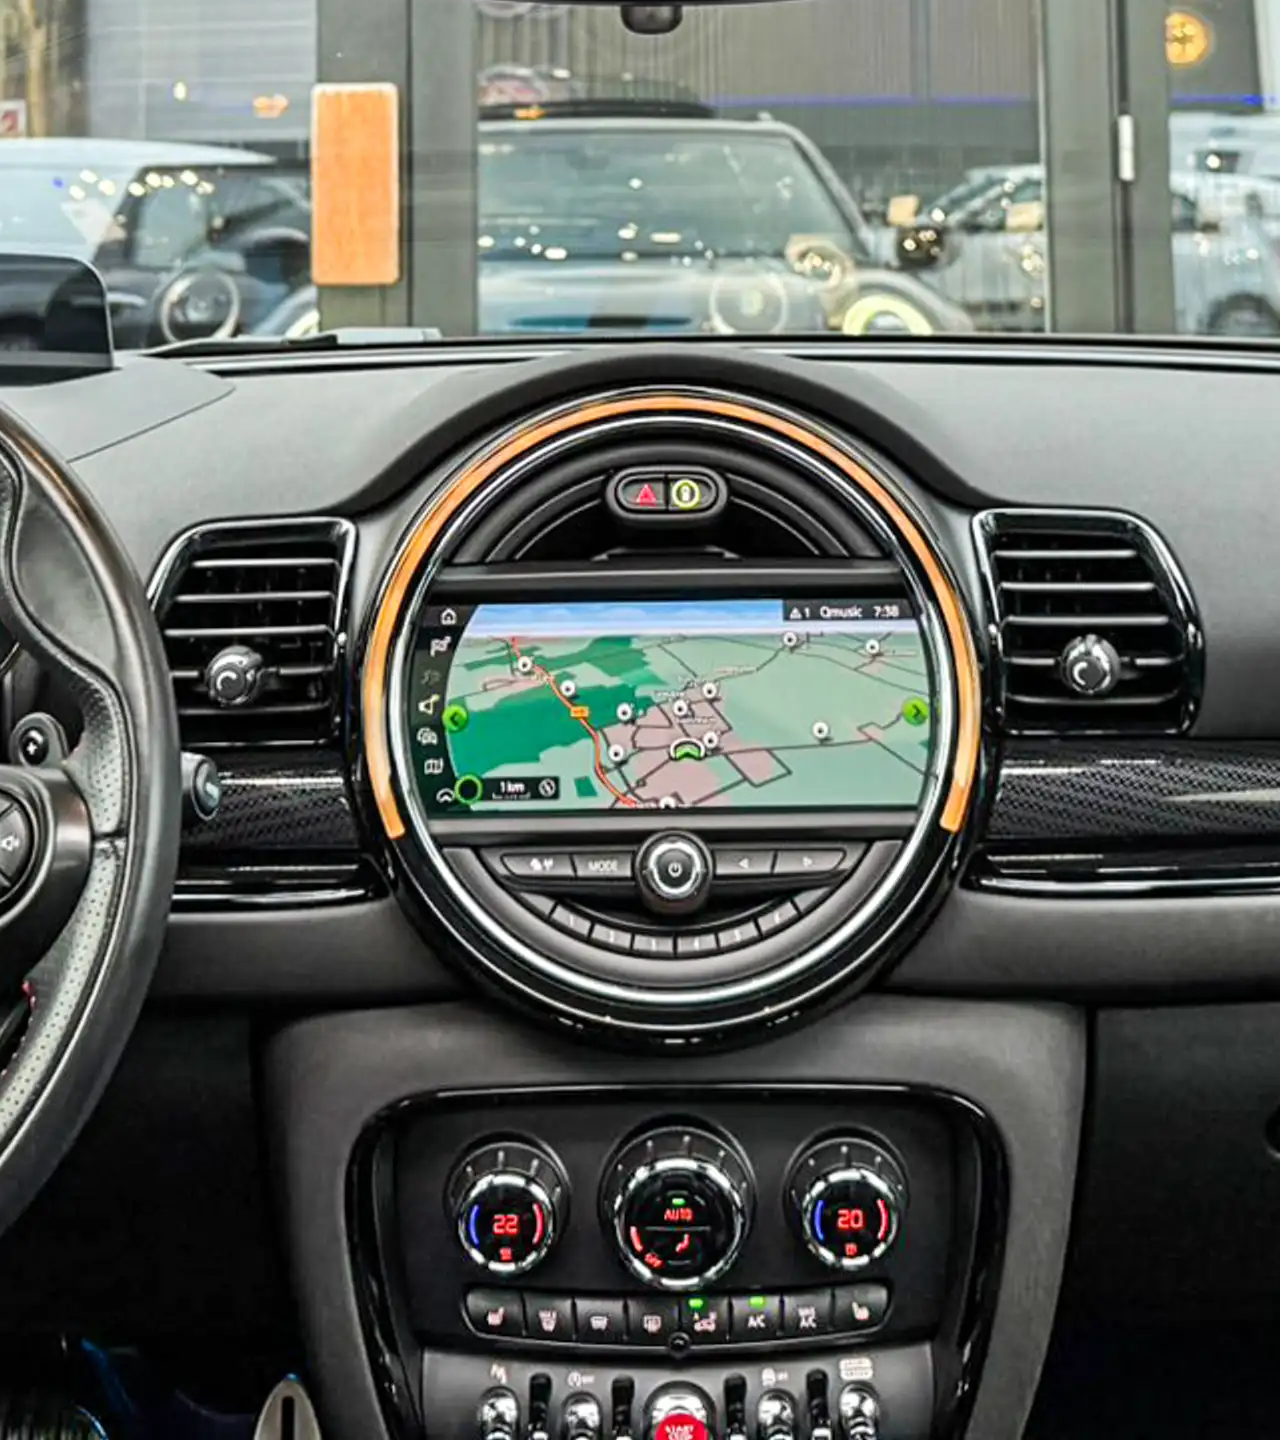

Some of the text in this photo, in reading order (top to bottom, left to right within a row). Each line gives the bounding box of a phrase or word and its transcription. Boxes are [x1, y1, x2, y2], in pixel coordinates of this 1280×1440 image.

[821, 604, 863, 619] Qmusic
[588, 859, 618, 872] MODE
[663, 1207, 693, 1222] AUTO
[836, 1208, 864, 1230] 20
[492, 1213, 518, 1236] 22
